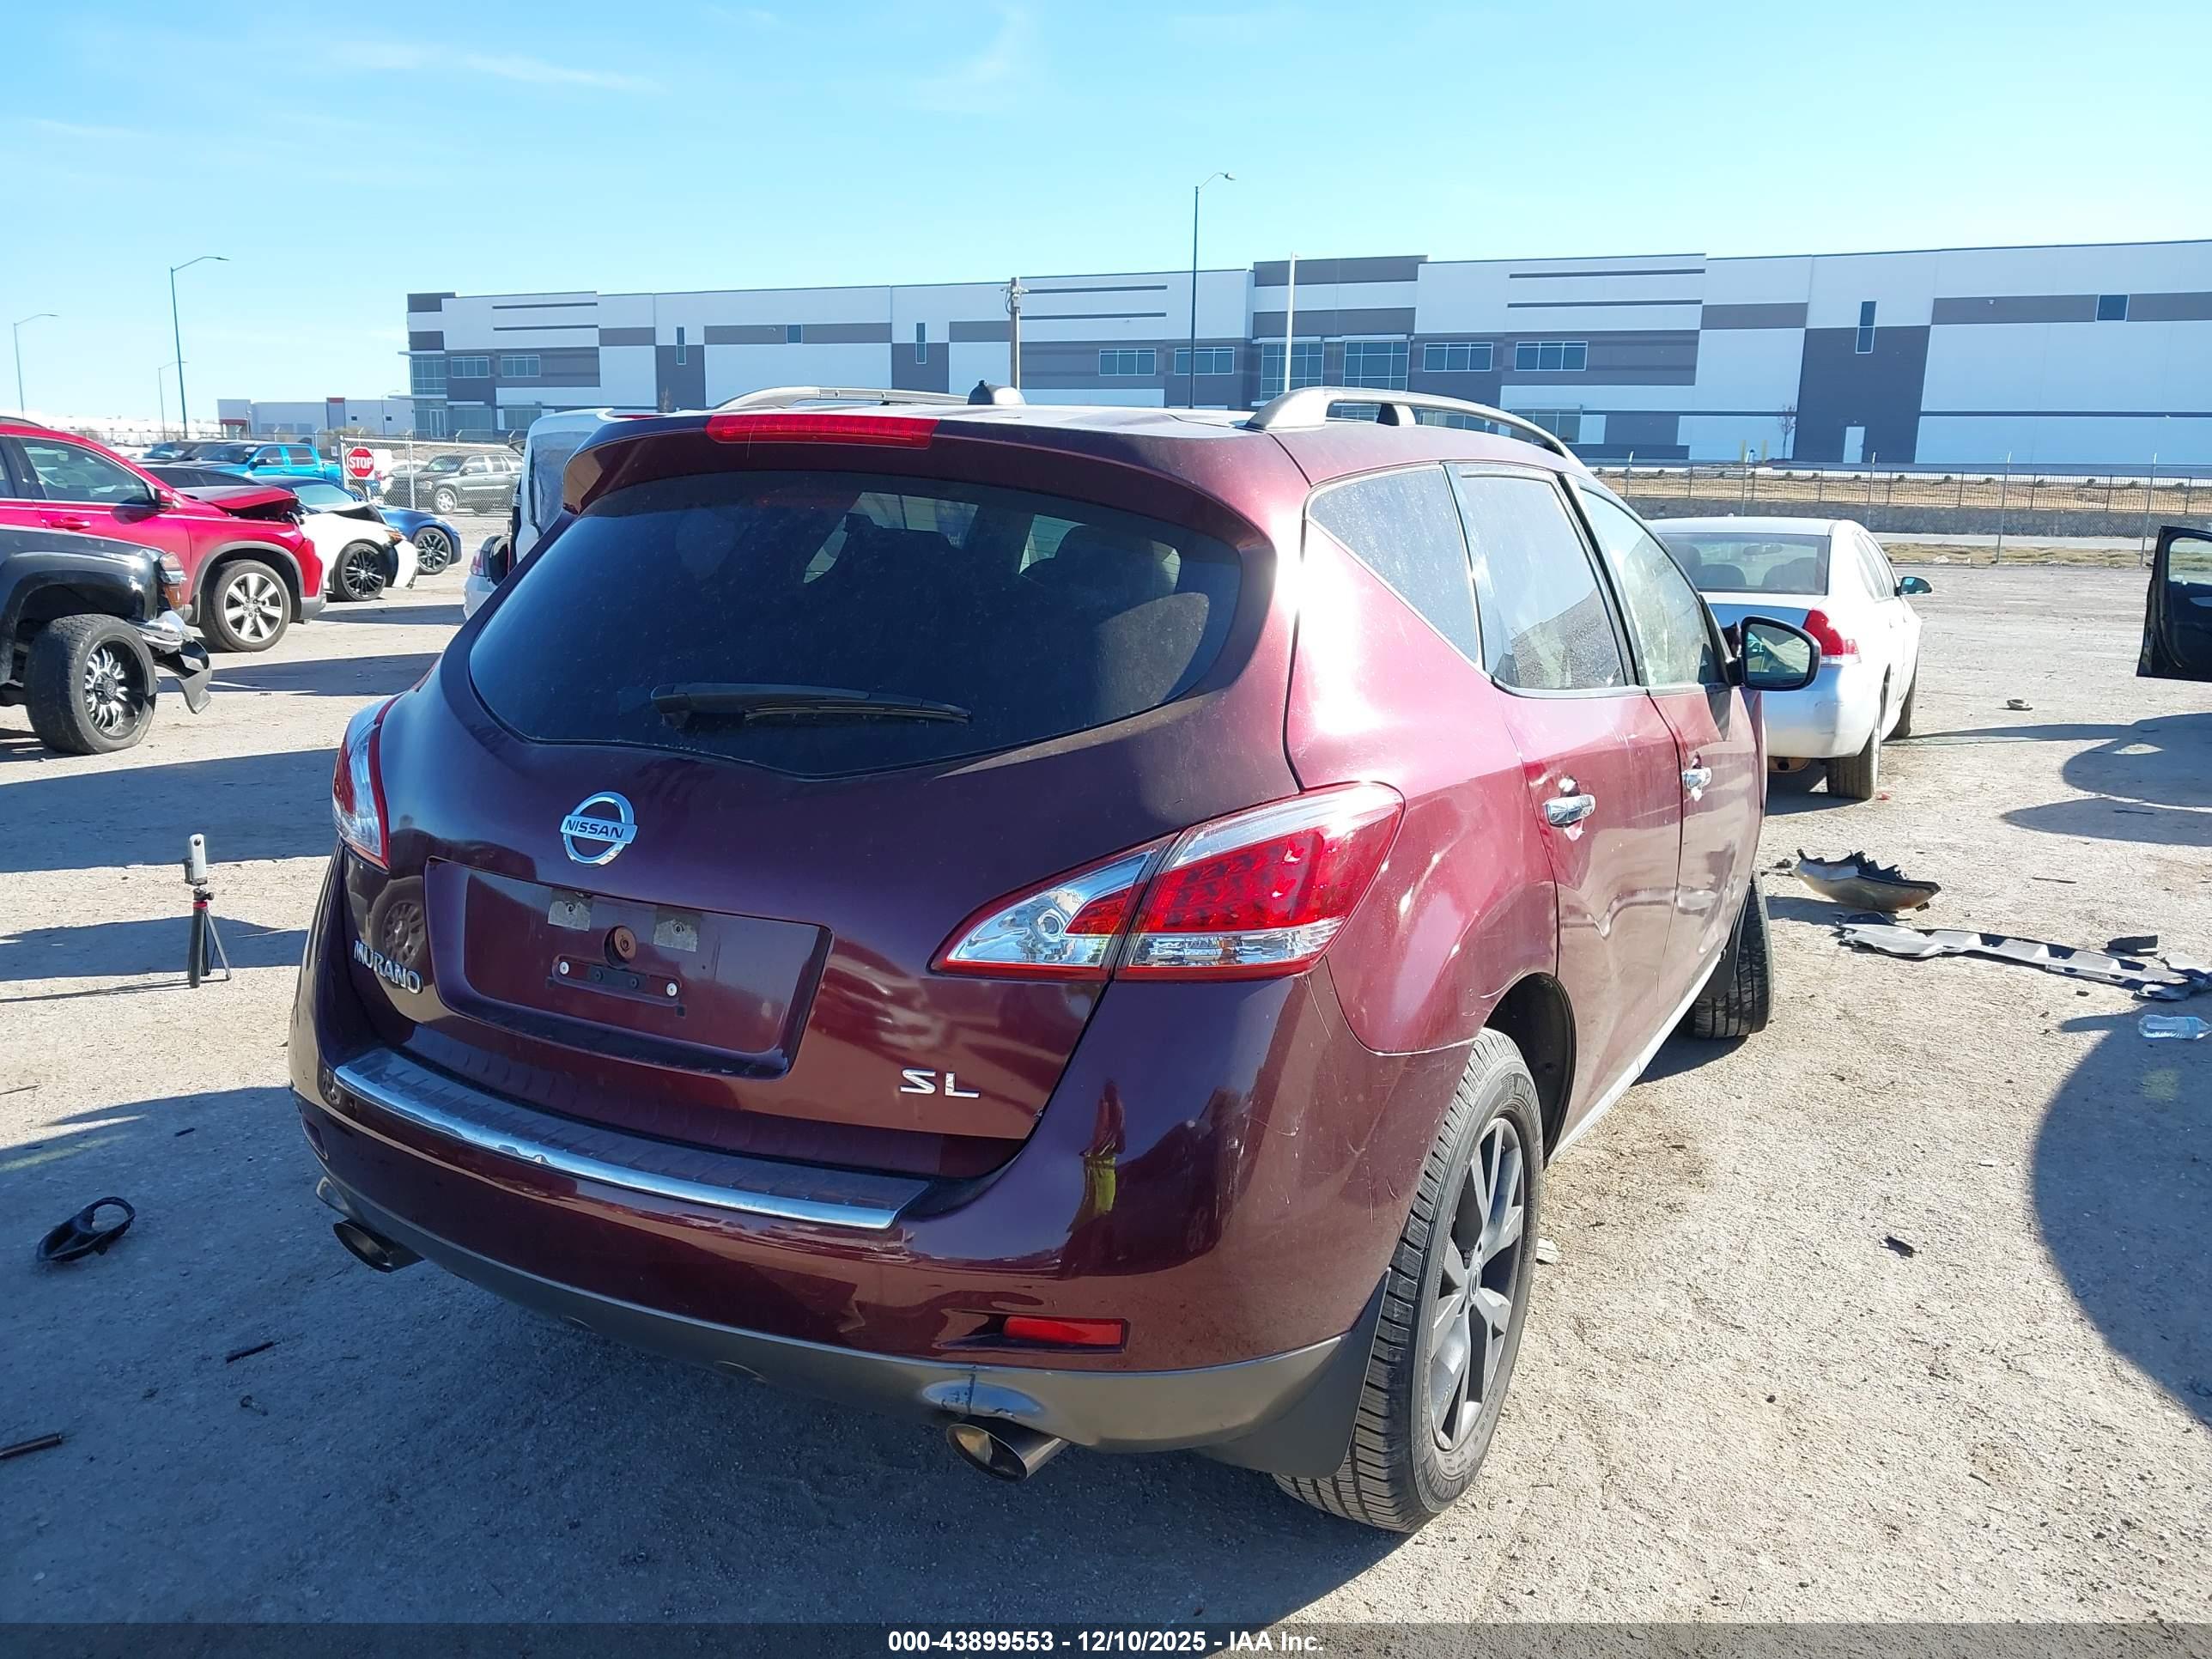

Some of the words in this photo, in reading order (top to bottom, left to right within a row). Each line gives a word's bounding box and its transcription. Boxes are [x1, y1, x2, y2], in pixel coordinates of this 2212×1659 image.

[349, 456, 374, 469] STOP
[564, 819, 625, 839] NISSAN
[354, 939, 423, 994] MURANO
[899, 1068, 980, 1098] SL
